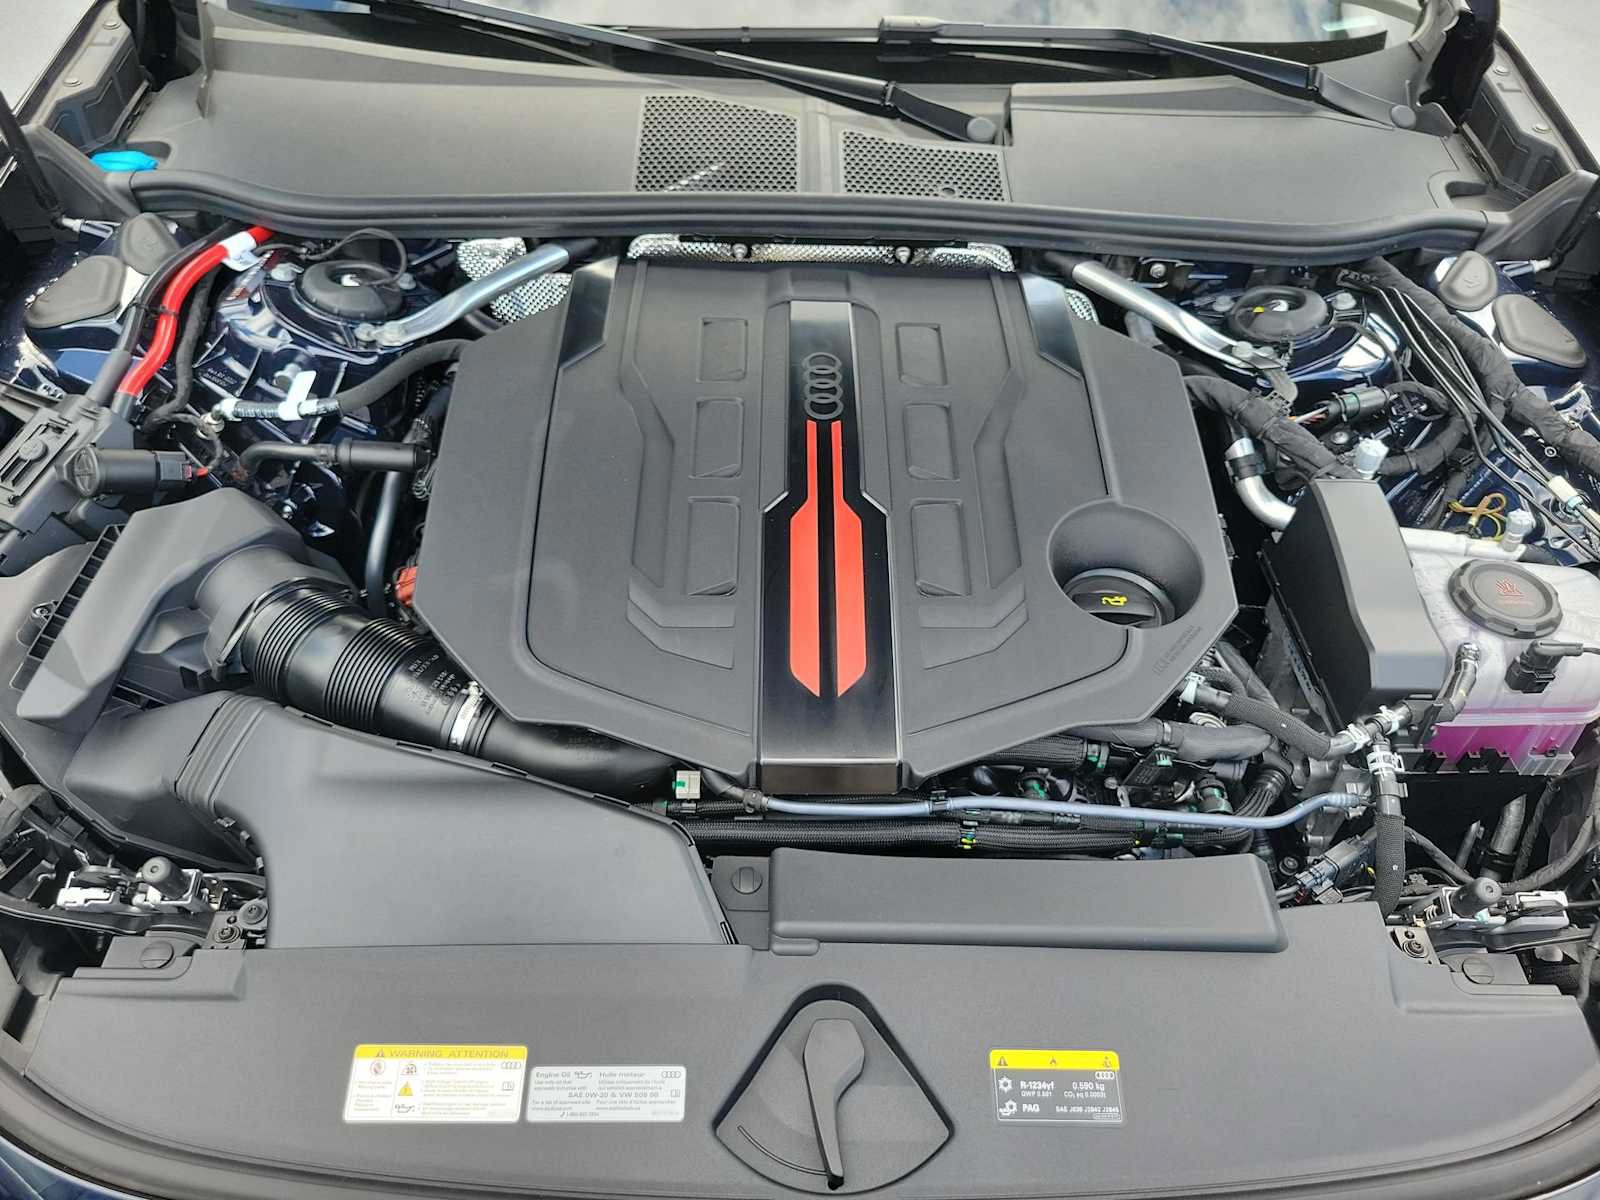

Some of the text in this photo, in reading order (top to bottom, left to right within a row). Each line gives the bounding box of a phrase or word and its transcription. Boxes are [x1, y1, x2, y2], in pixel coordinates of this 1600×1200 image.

[389, 1048, 509, 1058] WARNING ATTENTION
[536, 1071, 559, 1079] Engine
[1020, 1081, 1054, 1091] R-1234yf
[1096, 1081, 1105, 1091] kg
[1022, 1103, 1040, 1112] PAG
